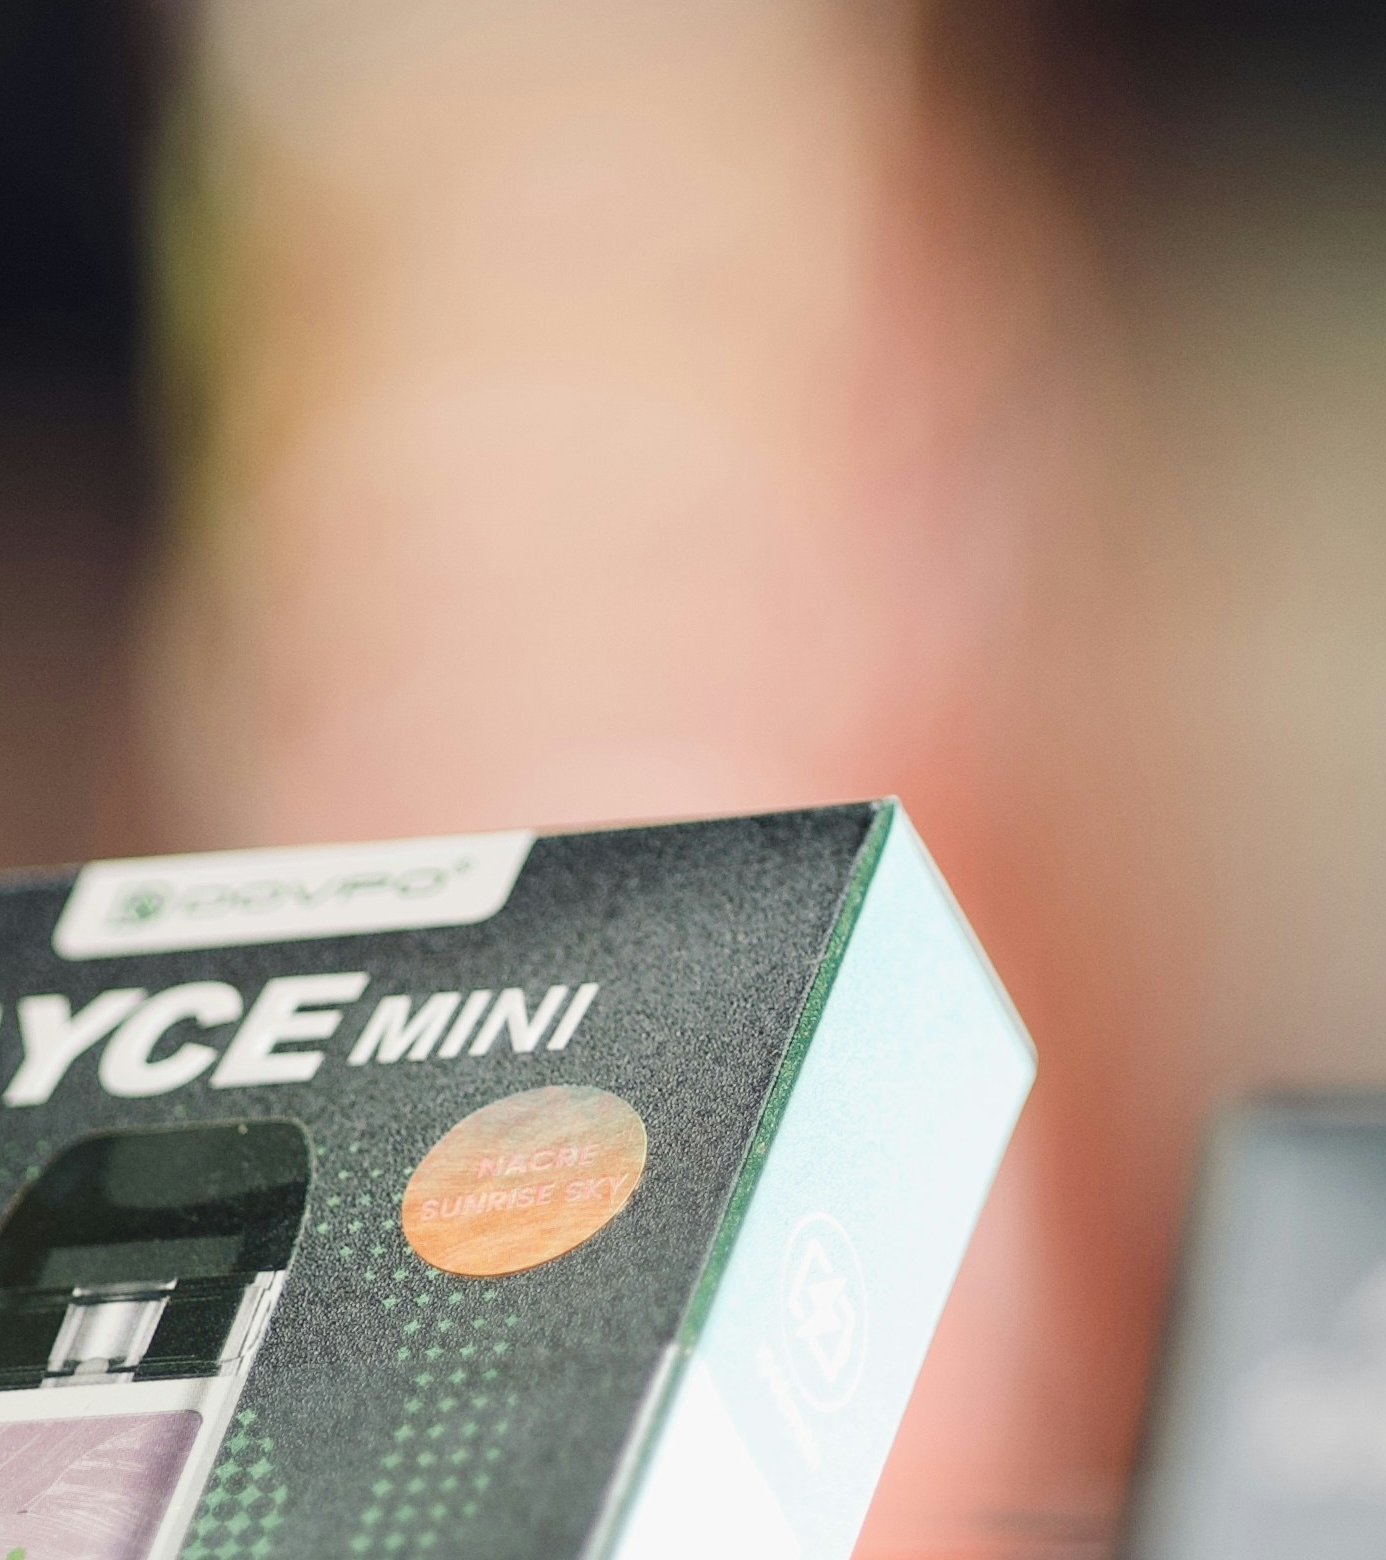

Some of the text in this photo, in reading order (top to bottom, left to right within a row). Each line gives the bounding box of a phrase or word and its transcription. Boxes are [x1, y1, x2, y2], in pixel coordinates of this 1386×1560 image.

[347, 982, 600, 1067] MINI
[477, 1142, 599, 1179] NACRE
[420, 1172, 630, 1221] SUNRISE SKY
